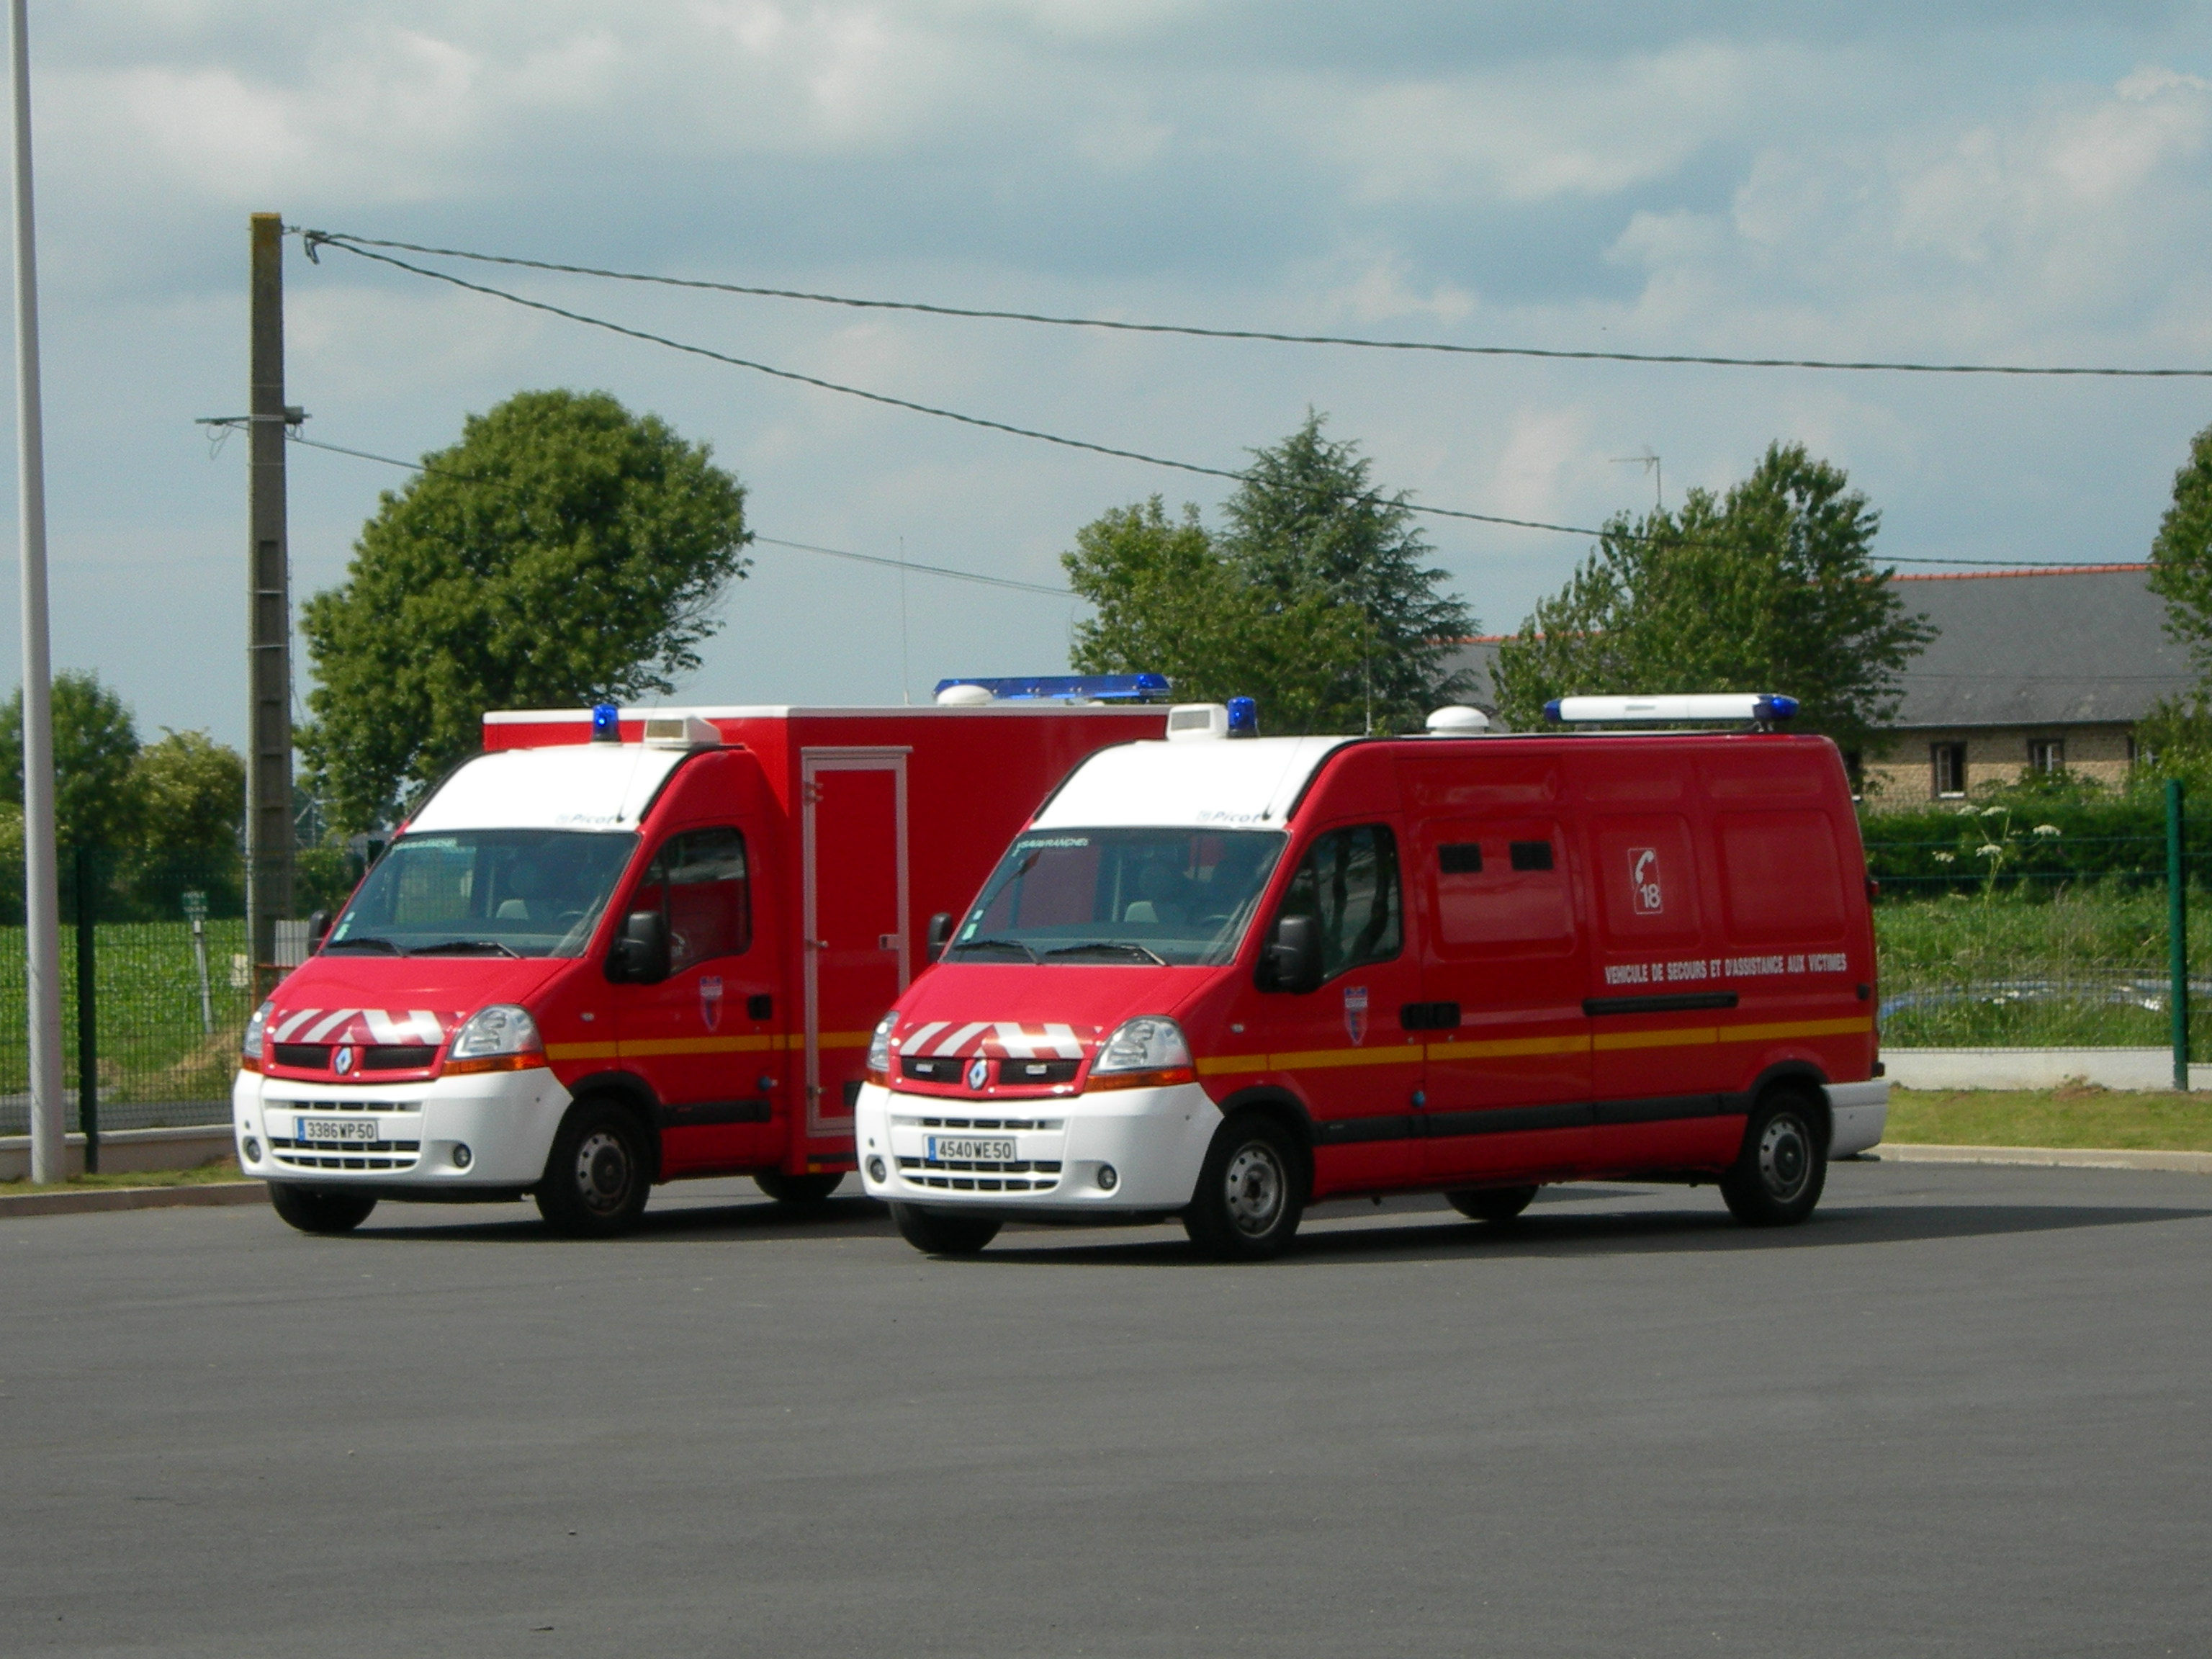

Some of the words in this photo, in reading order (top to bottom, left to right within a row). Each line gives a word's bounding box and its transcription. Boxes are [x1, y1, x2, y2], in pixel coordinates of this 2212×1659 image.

[1640, 884, 1660, 909] 18
[1652, 963, 1664, 982] DE
[1667, 960, 1708, 981] SECOURS
[1710, 959, 1722, 979] ET
[1725, 956, 1784, 977] D'ASSISTANCE
[1787, 954, 1805, 974] AUX
[1808, 952, 1848, 972] VICTIMES
